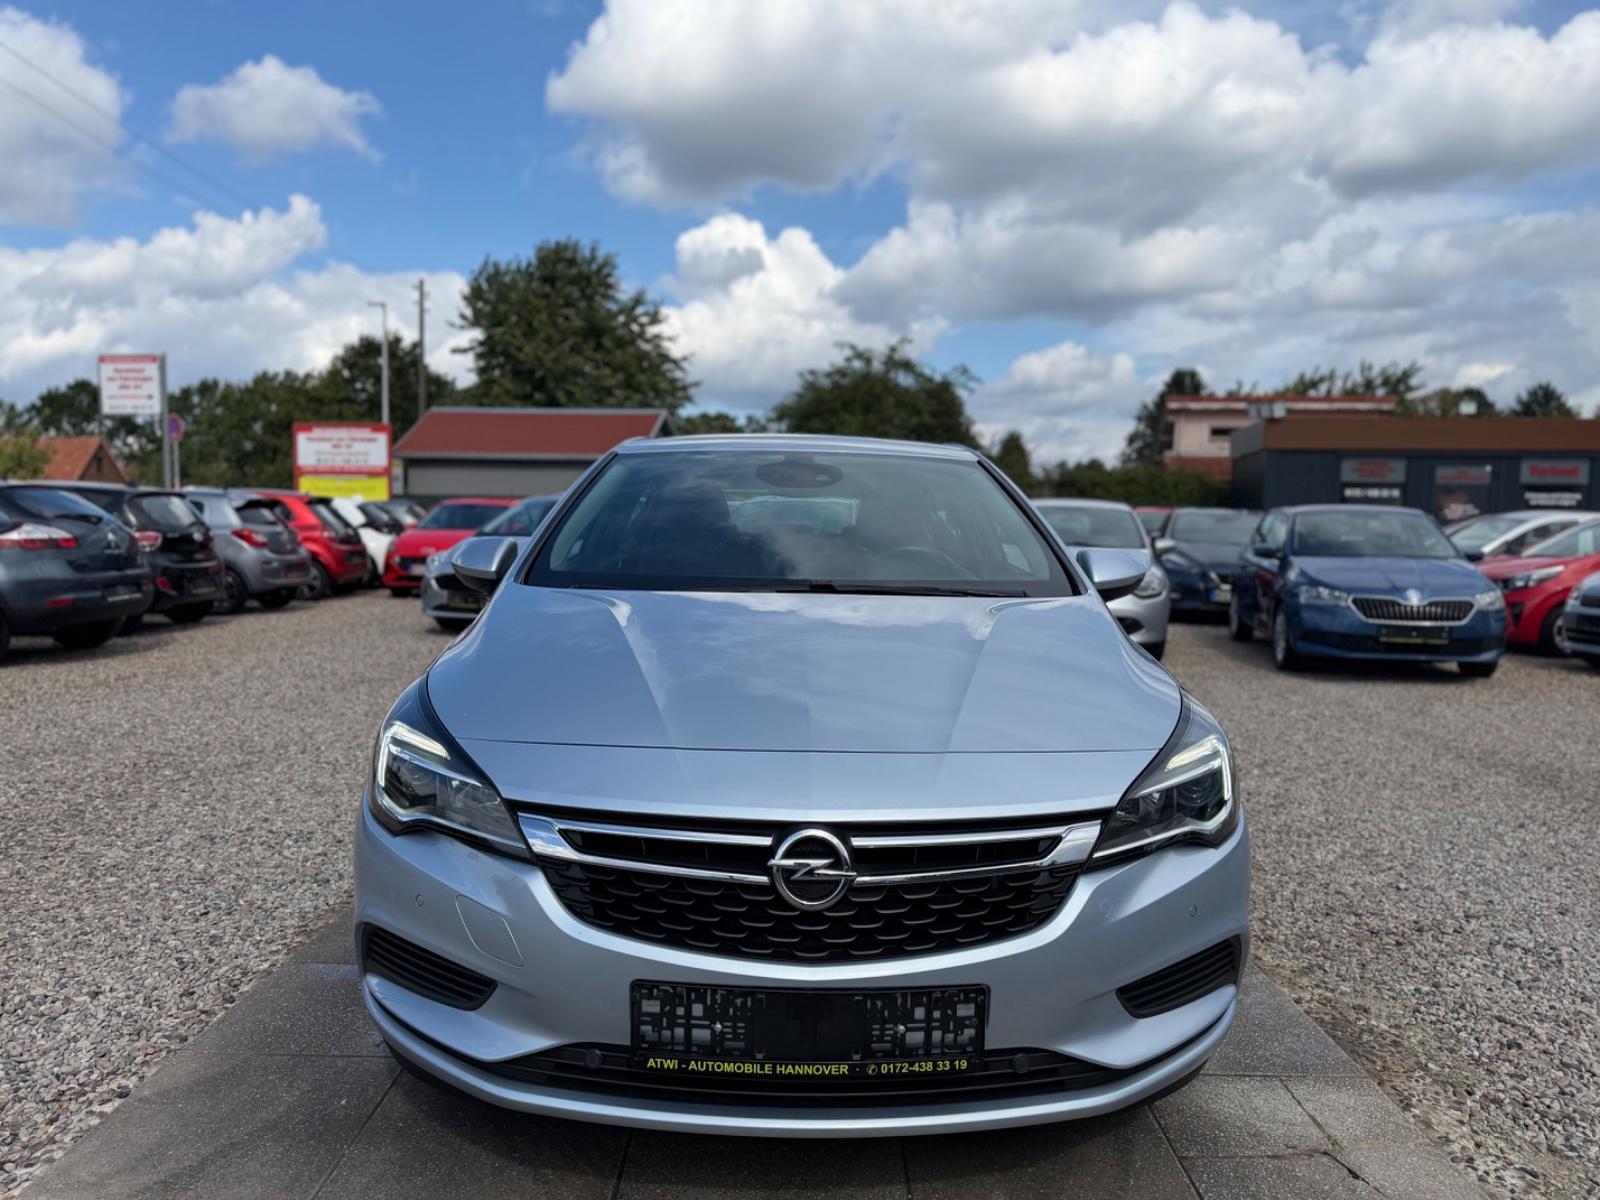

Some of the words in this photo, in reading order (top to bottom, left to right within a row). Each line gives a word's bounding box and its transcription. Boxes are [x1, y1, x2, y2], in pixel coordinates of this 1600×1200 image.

[646, 1058, 678, 1070] ATWI
[688, 1060, 773, 1074] AUTOMOBILE
[776, 1064, 848, 1075] HANNOVER
[881, 1061, 933, 1074] 0172-438
[936, 1060, 950, 1071] 33
[953, 1059, 968, 1070] 19
